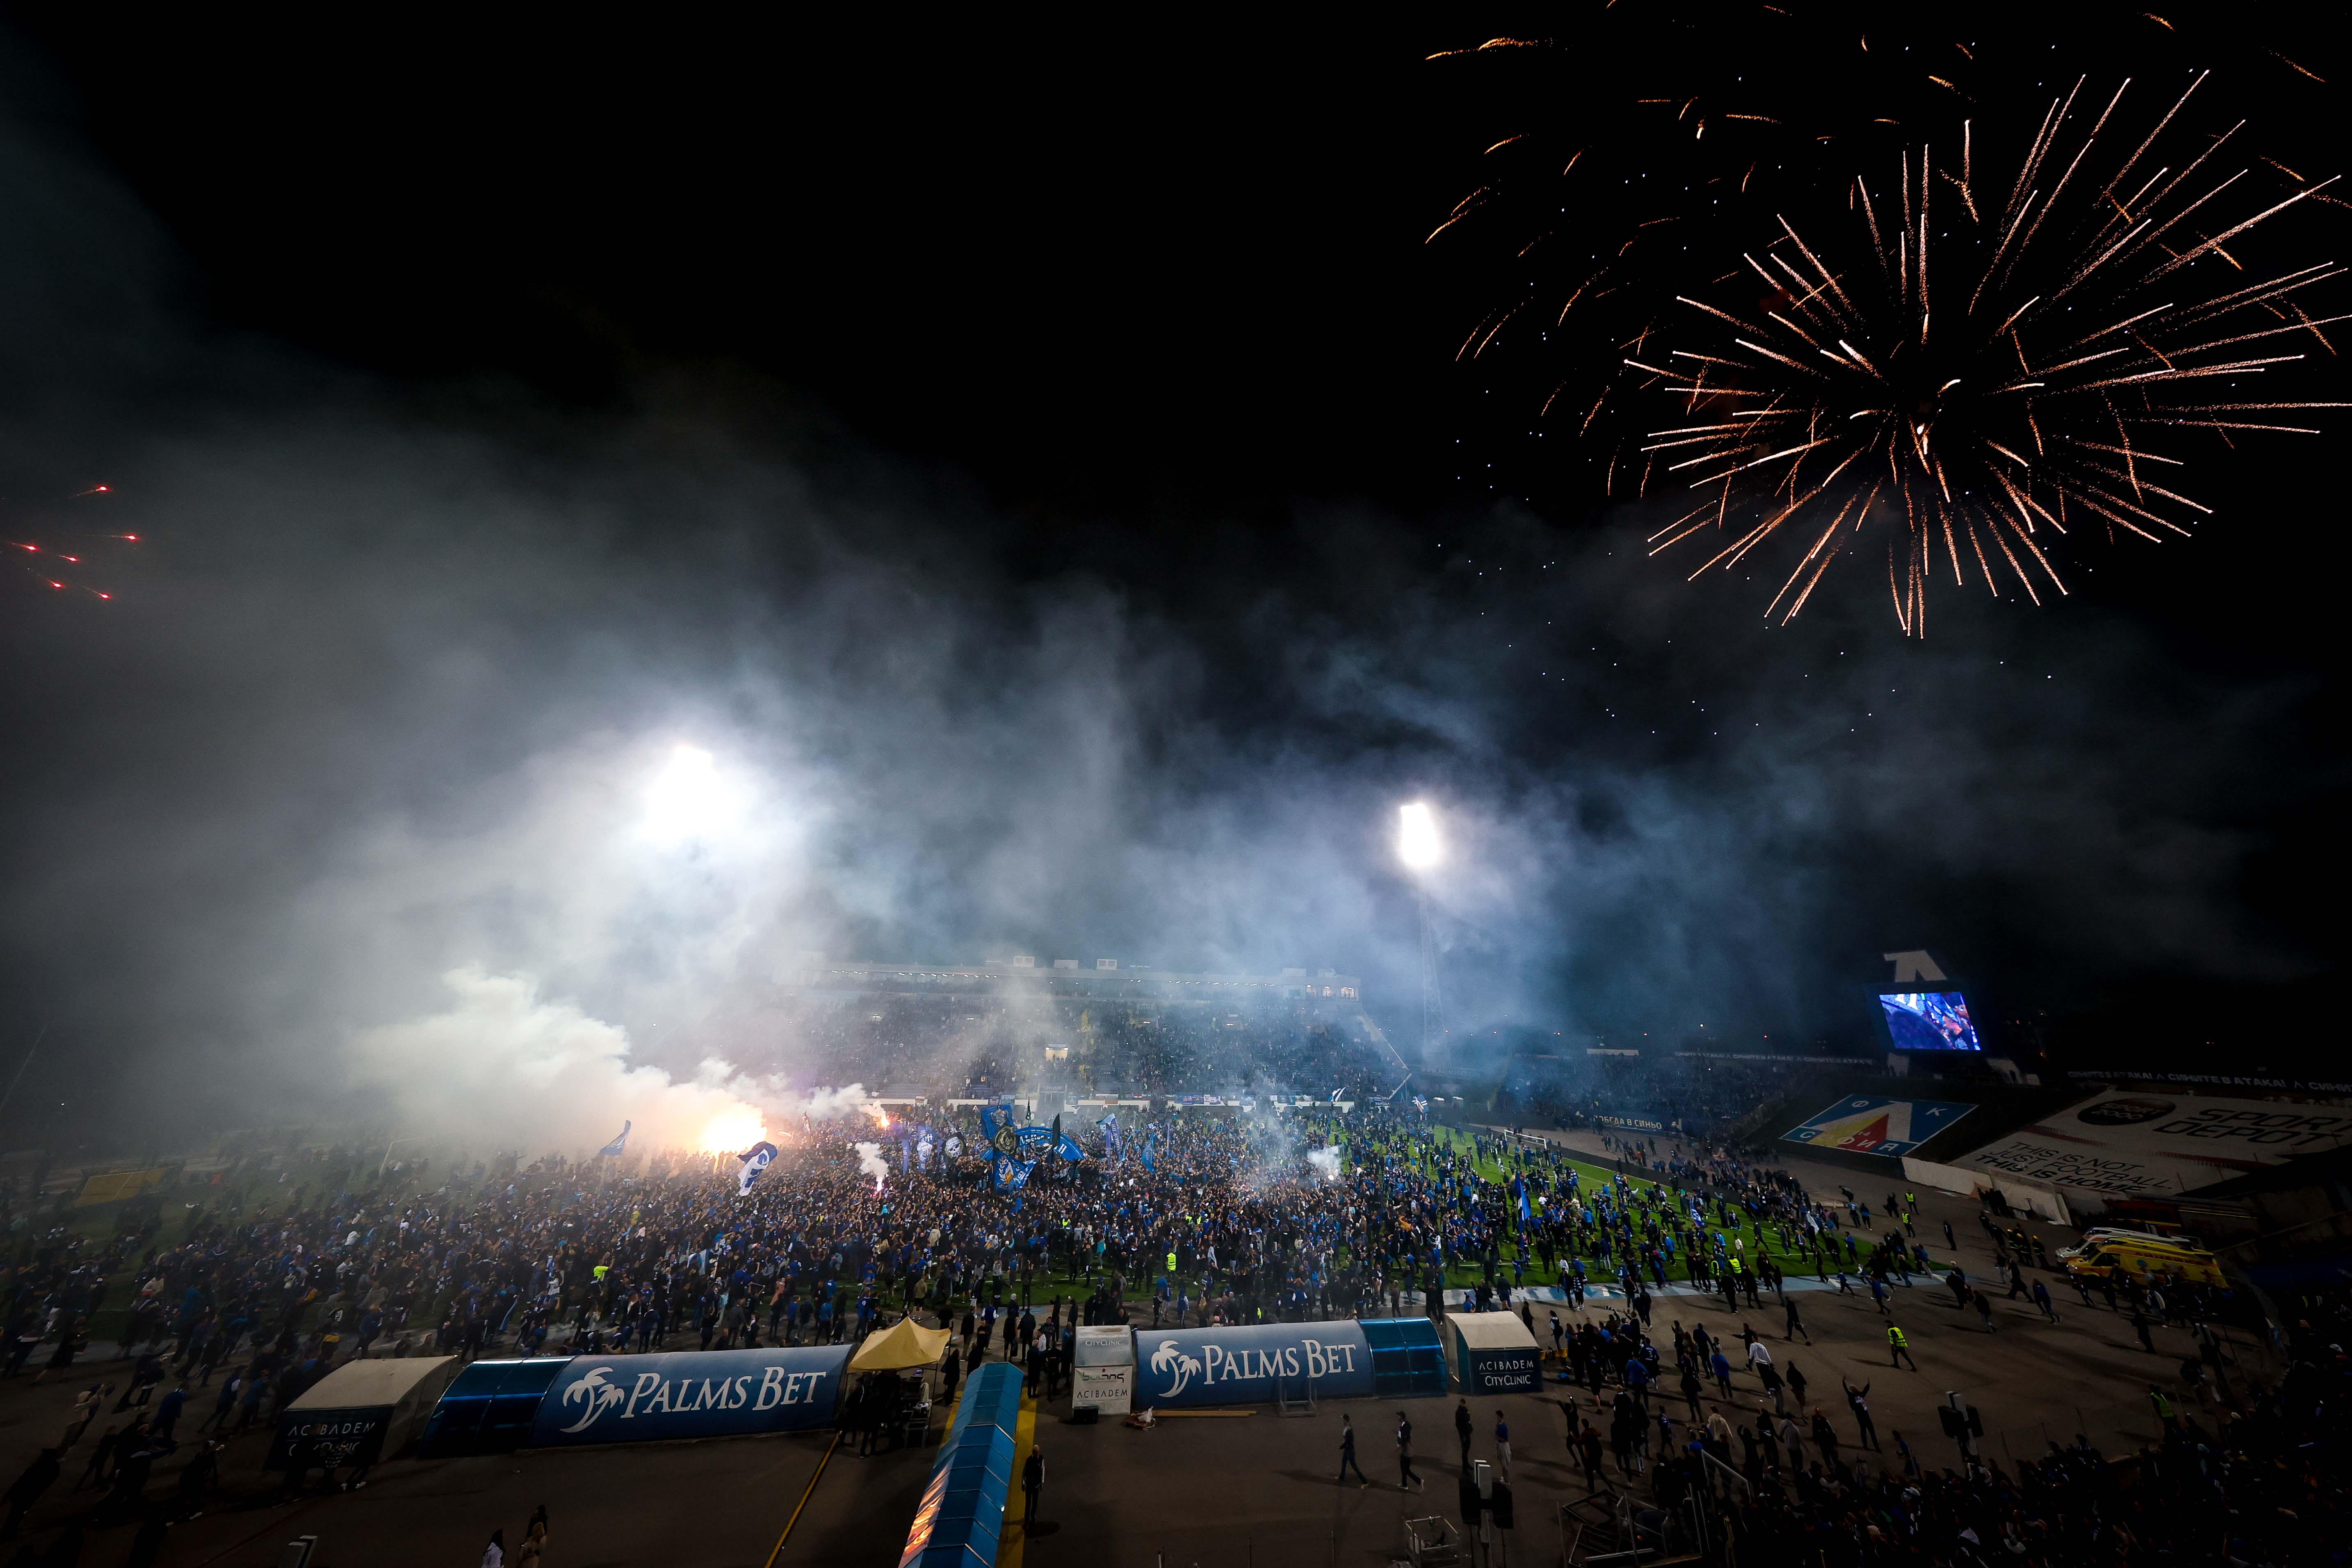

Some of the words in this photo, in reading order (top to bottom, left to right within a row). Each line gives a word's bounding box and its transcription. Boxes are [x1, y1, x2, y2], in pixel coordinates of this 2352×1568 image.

[2153, 1120, 2343, 1146] DEPOT
[1975, 1154, 2028, 1172] THIS
[1990, 1150, 2046, 1165] JUST
[2010, 1142, 2060, 1158] THIS
[2058, 1153, 2085, 1162] IS
[2086, 1158, 2145, 1172] NOT
[1202, 1345, 1299, 1385] PALMS
[1301, 1339, 1356, 1378] BET
[1479, 1360, 1534, 1370] ACIBADEM
[621, 1372, 752, 1418] PALMS
[753, 1366, 826, 1411] BET
[1077, 1389, 1128, 1399] ACIBADEM
